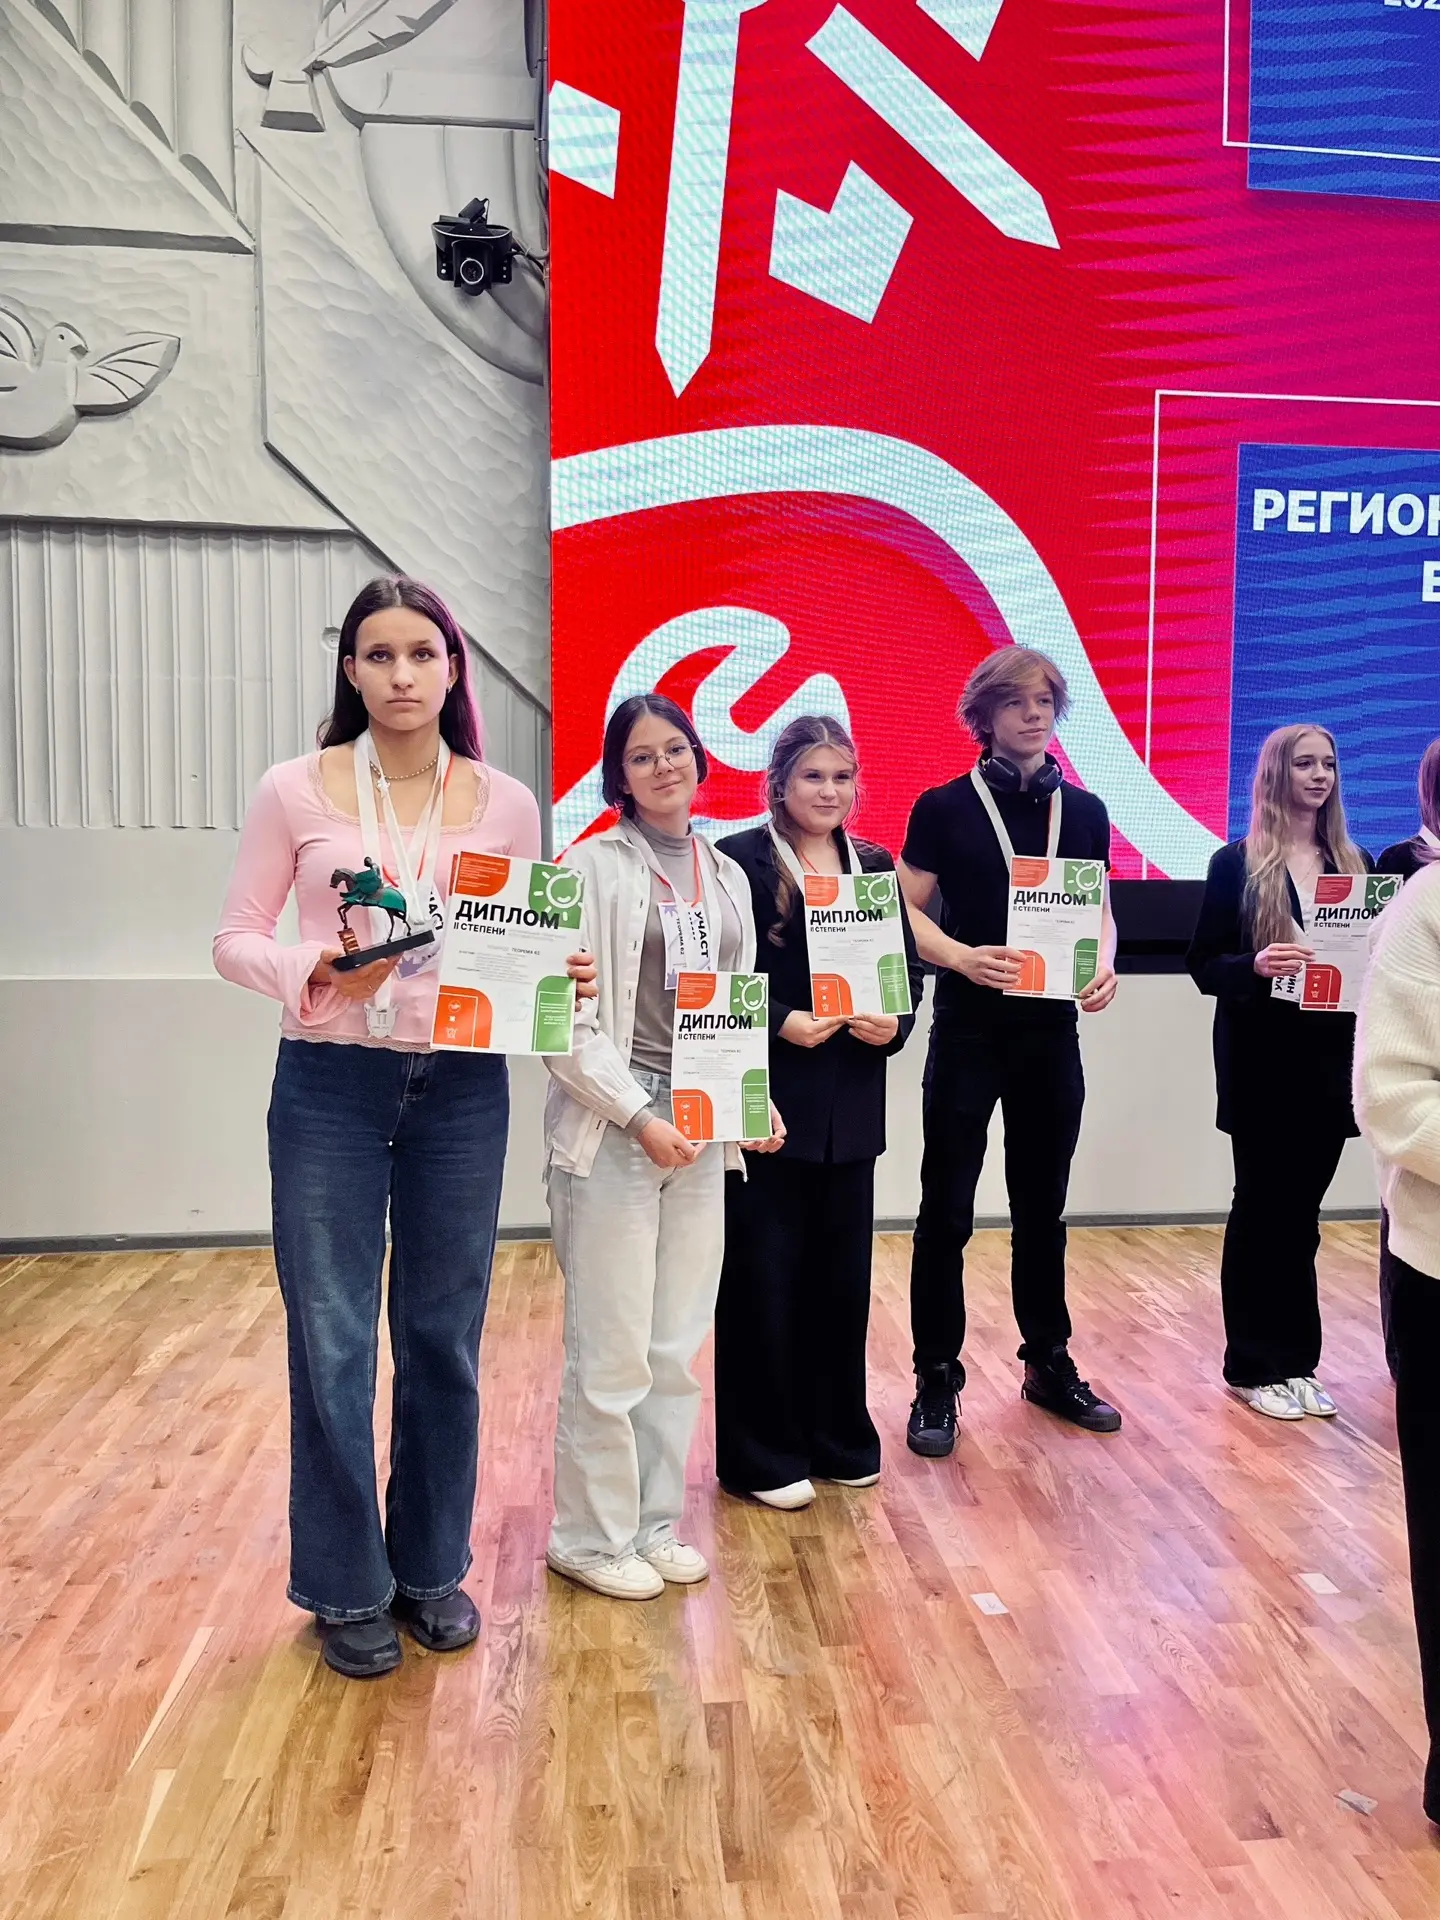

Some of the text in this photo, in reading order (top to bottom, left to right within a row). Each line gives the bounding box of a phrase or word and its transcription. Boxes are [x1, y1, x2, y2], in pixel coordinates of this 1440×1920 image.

[1014, 890, 1086, 907] ДИПЛОМ
[455, 900, 560, 929] ДИПЛОМ
[810, 909, 883, 926] ДИПЛОМ
[453, 921, 459, 930] II
[461, 922, 506, 936] СТЕПЕНИ
[1275, 975, 1285, 991] УЧ
[679, 1014, 752, 1032] ДИПЛОМ
